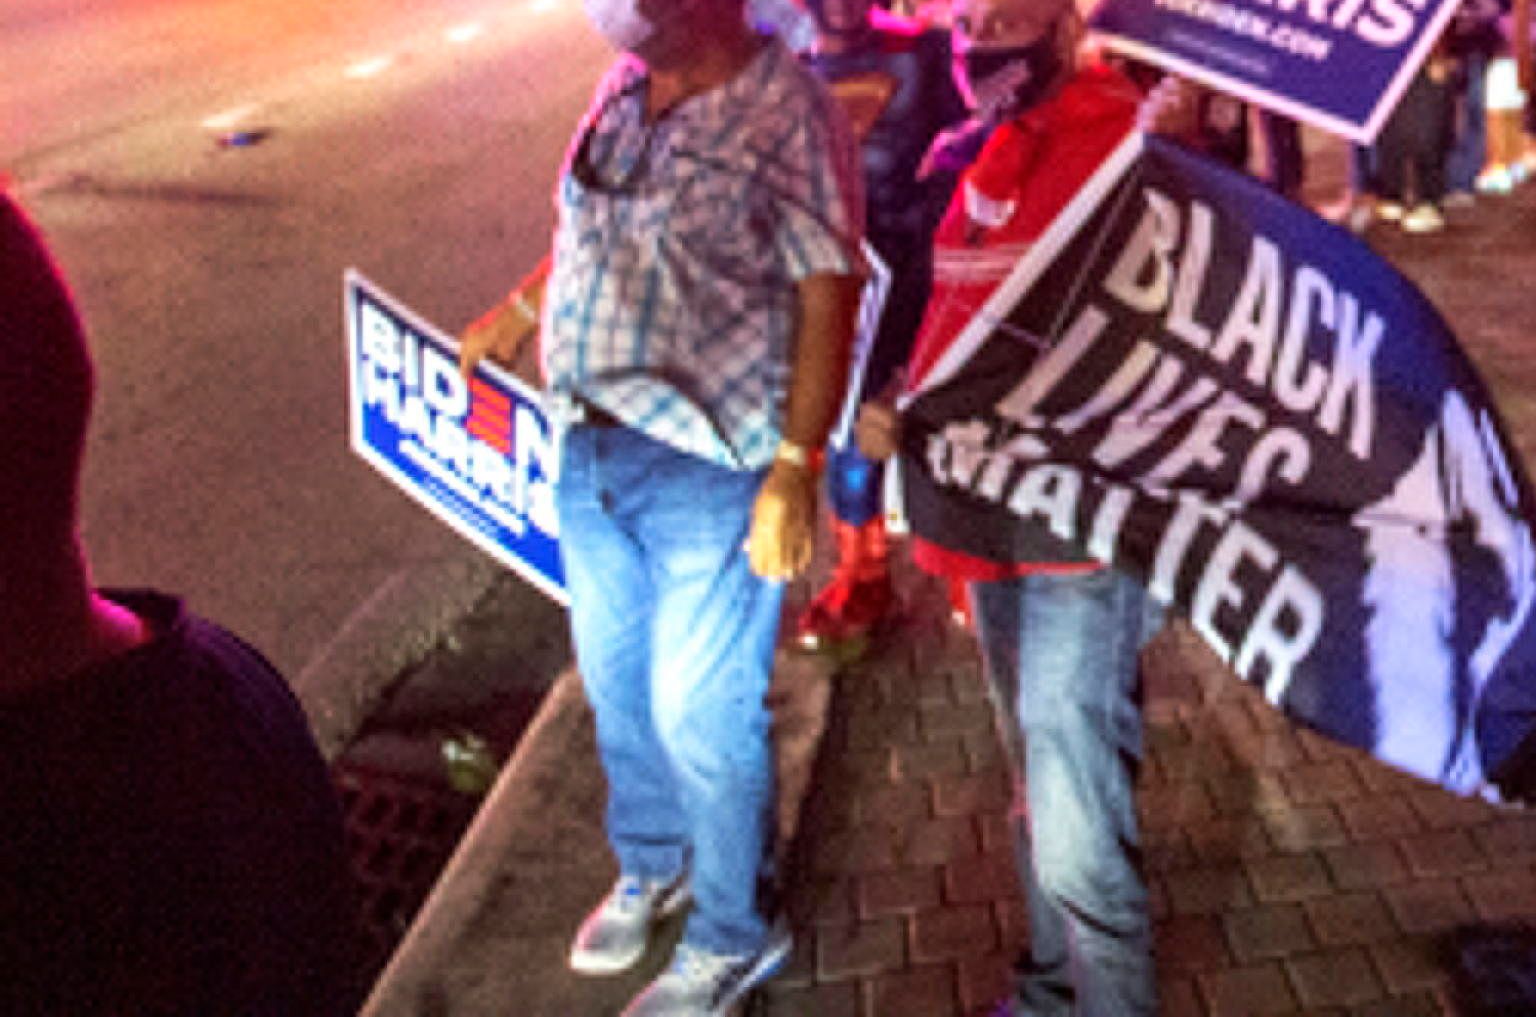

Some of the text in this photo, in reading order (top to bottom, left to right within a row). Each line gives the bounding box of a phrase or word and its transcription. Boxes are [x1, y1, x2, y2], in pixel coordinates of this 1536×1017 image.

[361, 300, 560, 484] BIDEN
[1102, 187, 1385, 460] BLACK
[927, 417, 1324, 709] MATTER
